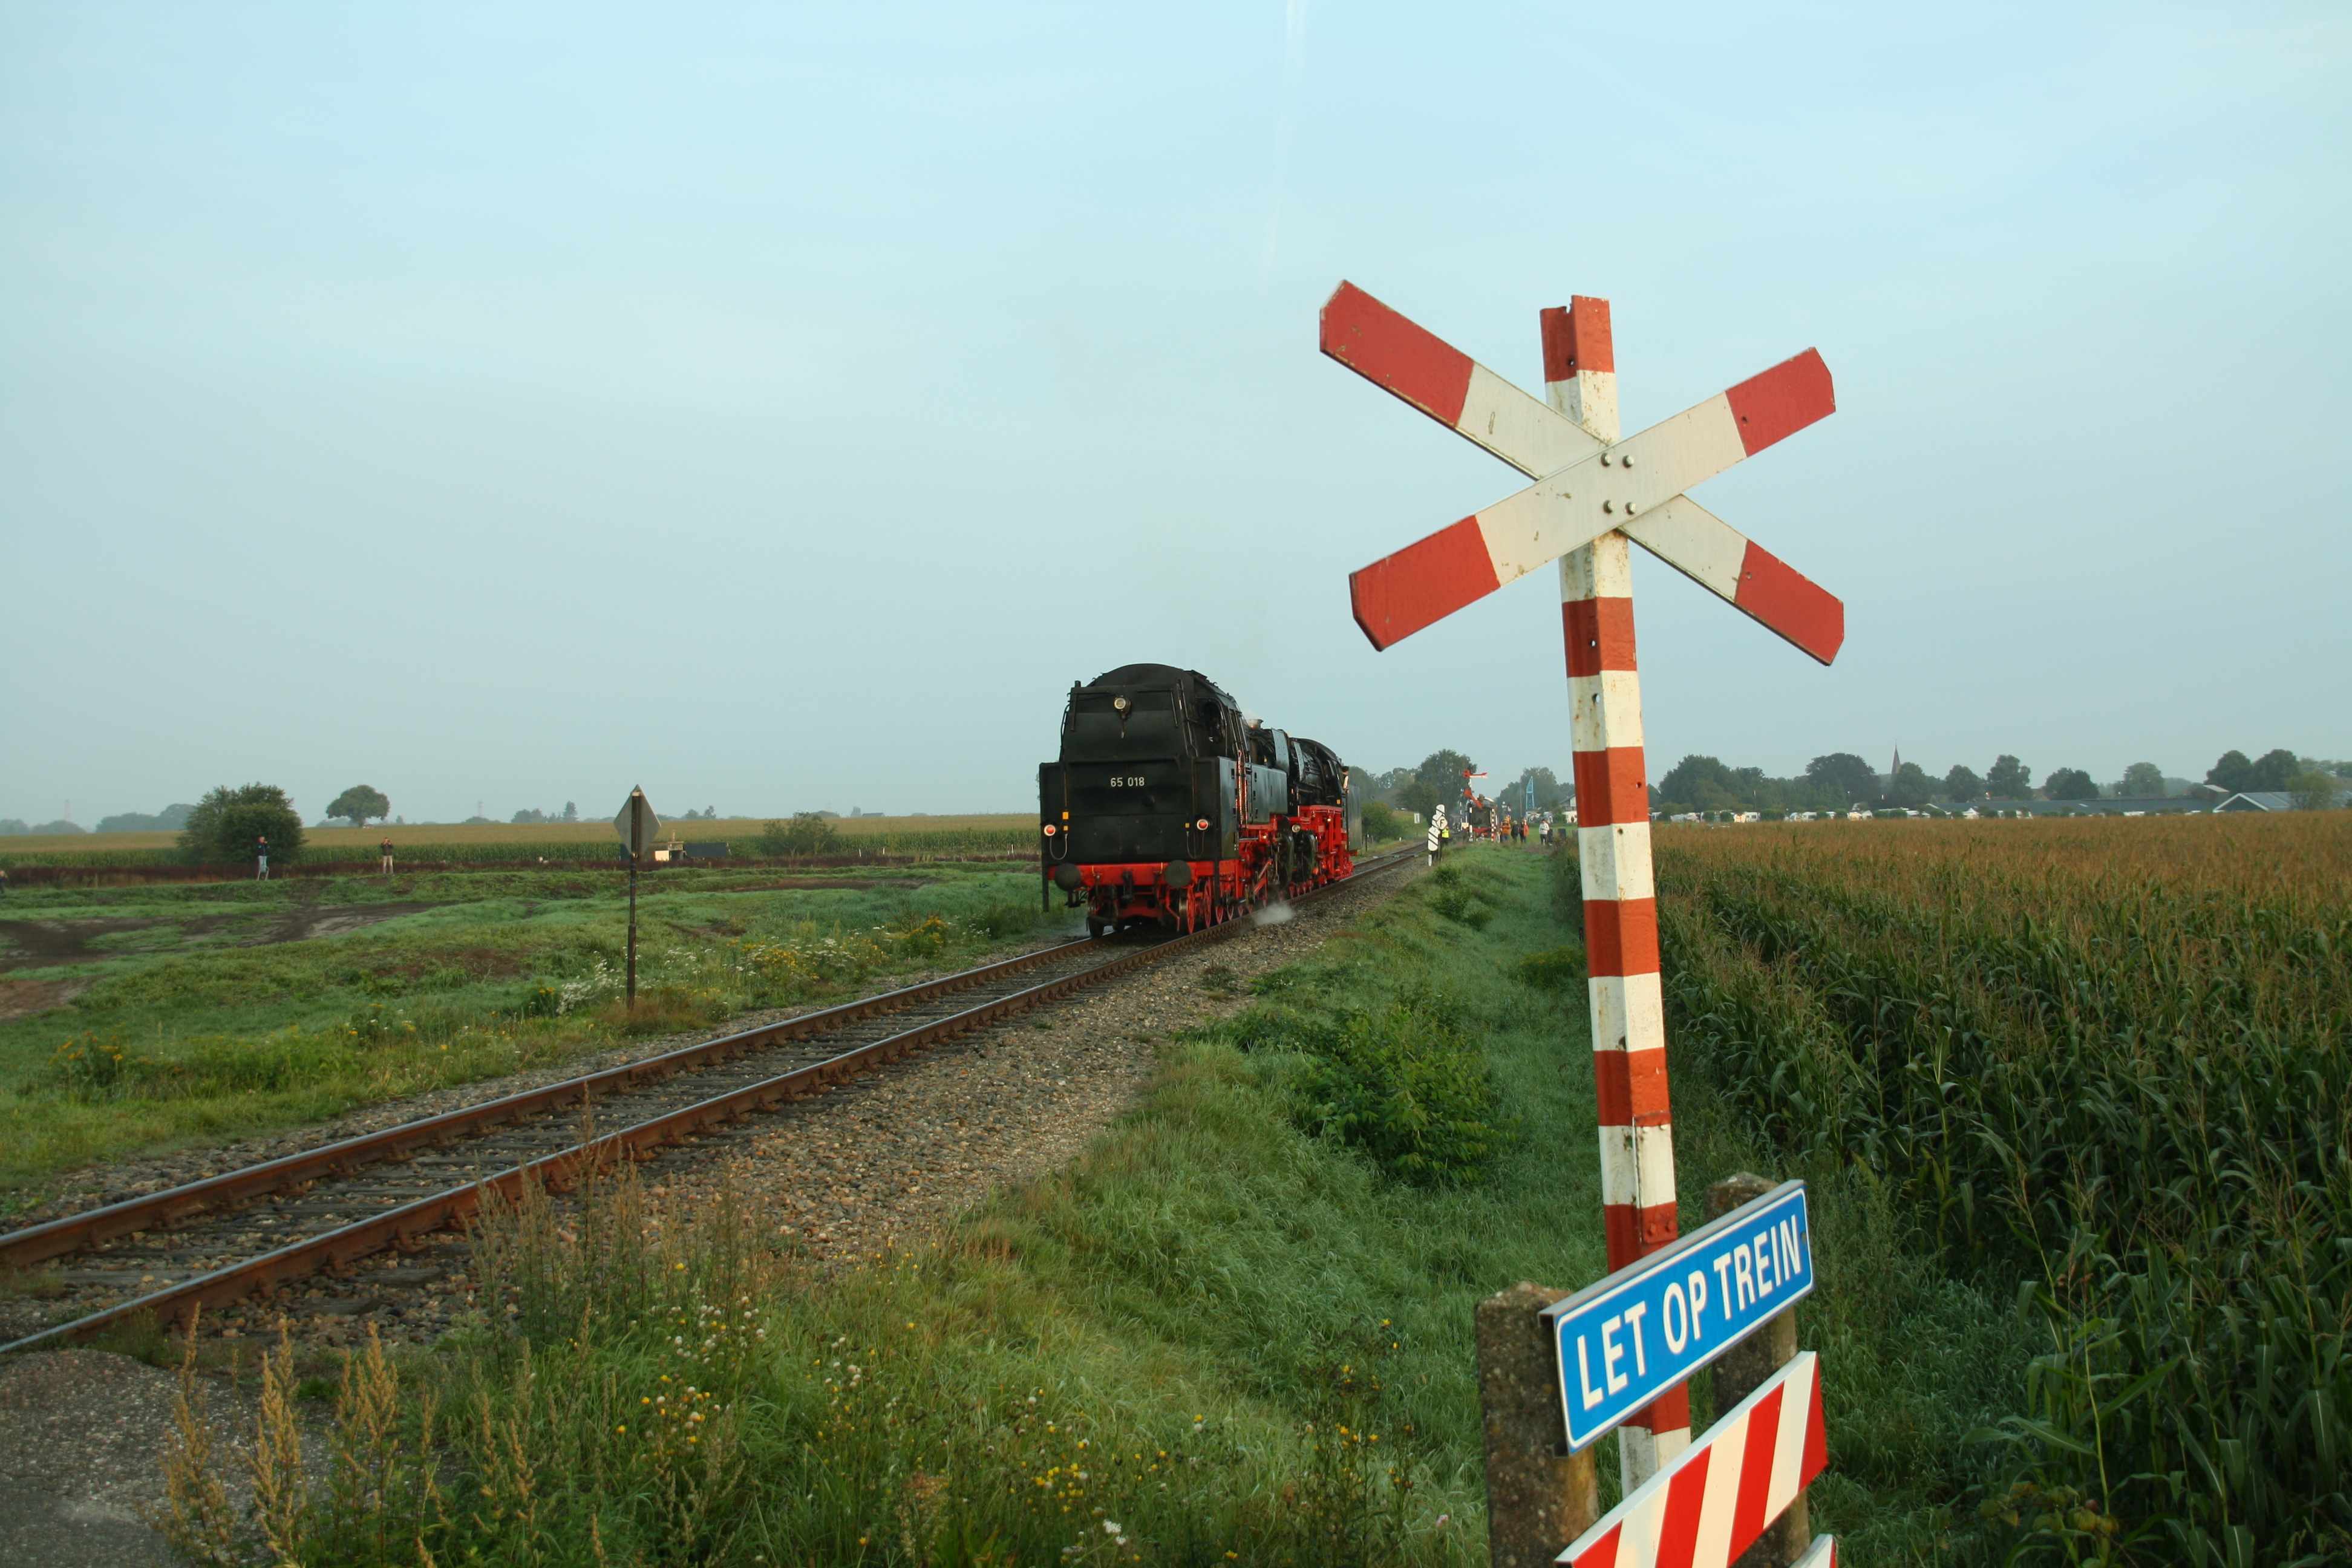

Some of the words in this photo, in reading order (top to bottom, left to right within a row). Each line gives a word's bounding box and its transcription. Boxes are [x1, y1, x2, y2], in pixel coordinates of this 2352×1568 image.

[1110, 777, 1123, 787] 65
[1127, 776, 1145, 786] 018
[1576, 1300, 1647, 1411] LET
[1662, 1269, 1707, 1355] OP
[1713, 1214, 1802, 1321] TREIN
